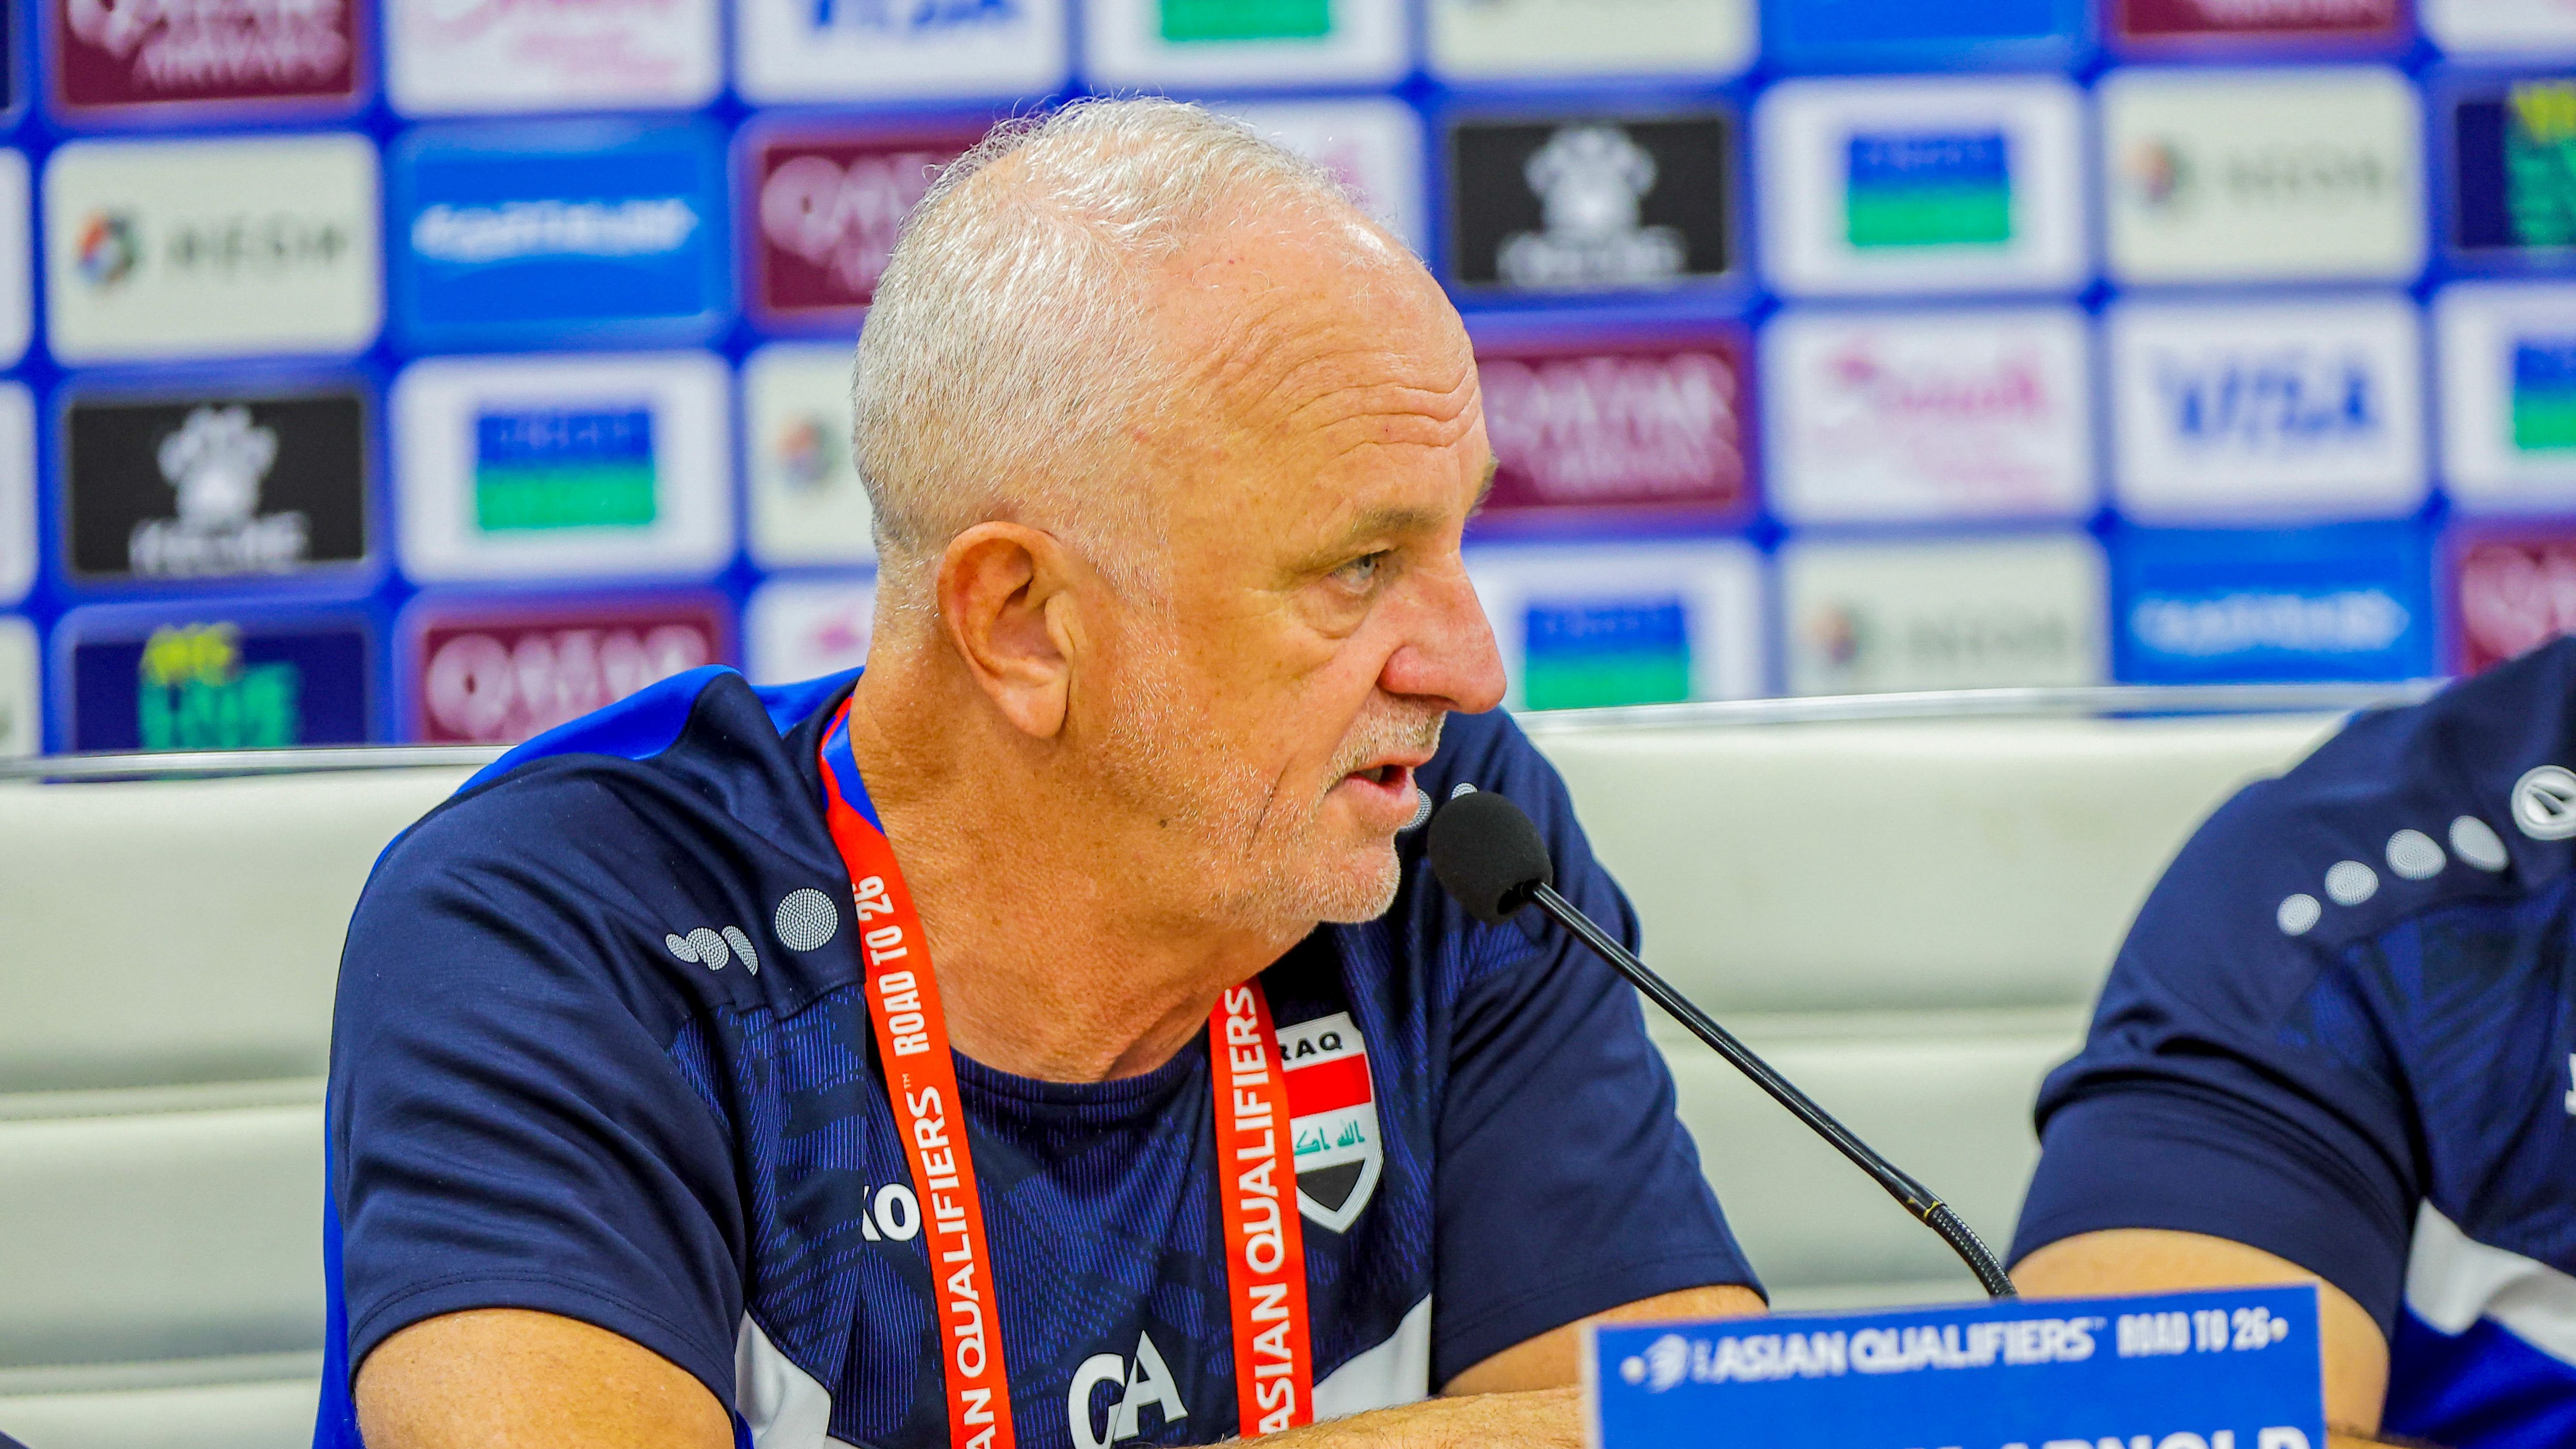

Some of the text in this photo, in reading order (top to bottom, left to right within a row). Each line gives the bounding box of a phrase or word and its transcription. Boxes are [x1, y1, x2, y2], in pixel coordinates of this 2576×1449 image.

[852, 875, 895, 921] 26
[866, 925, 908, 966] TO
[879, 971, 930, 1057] ROAD
[1225, 986, 1295, 1435] ASIAN QUALIFIERS
[1709, 1331, 1848, 1383] ASIAN
[2116, 1311, 2191, 1358] ROAD
[2192, 1308, 2229, 1353] TO
[2231, 1305, 2271, 1352] 26
